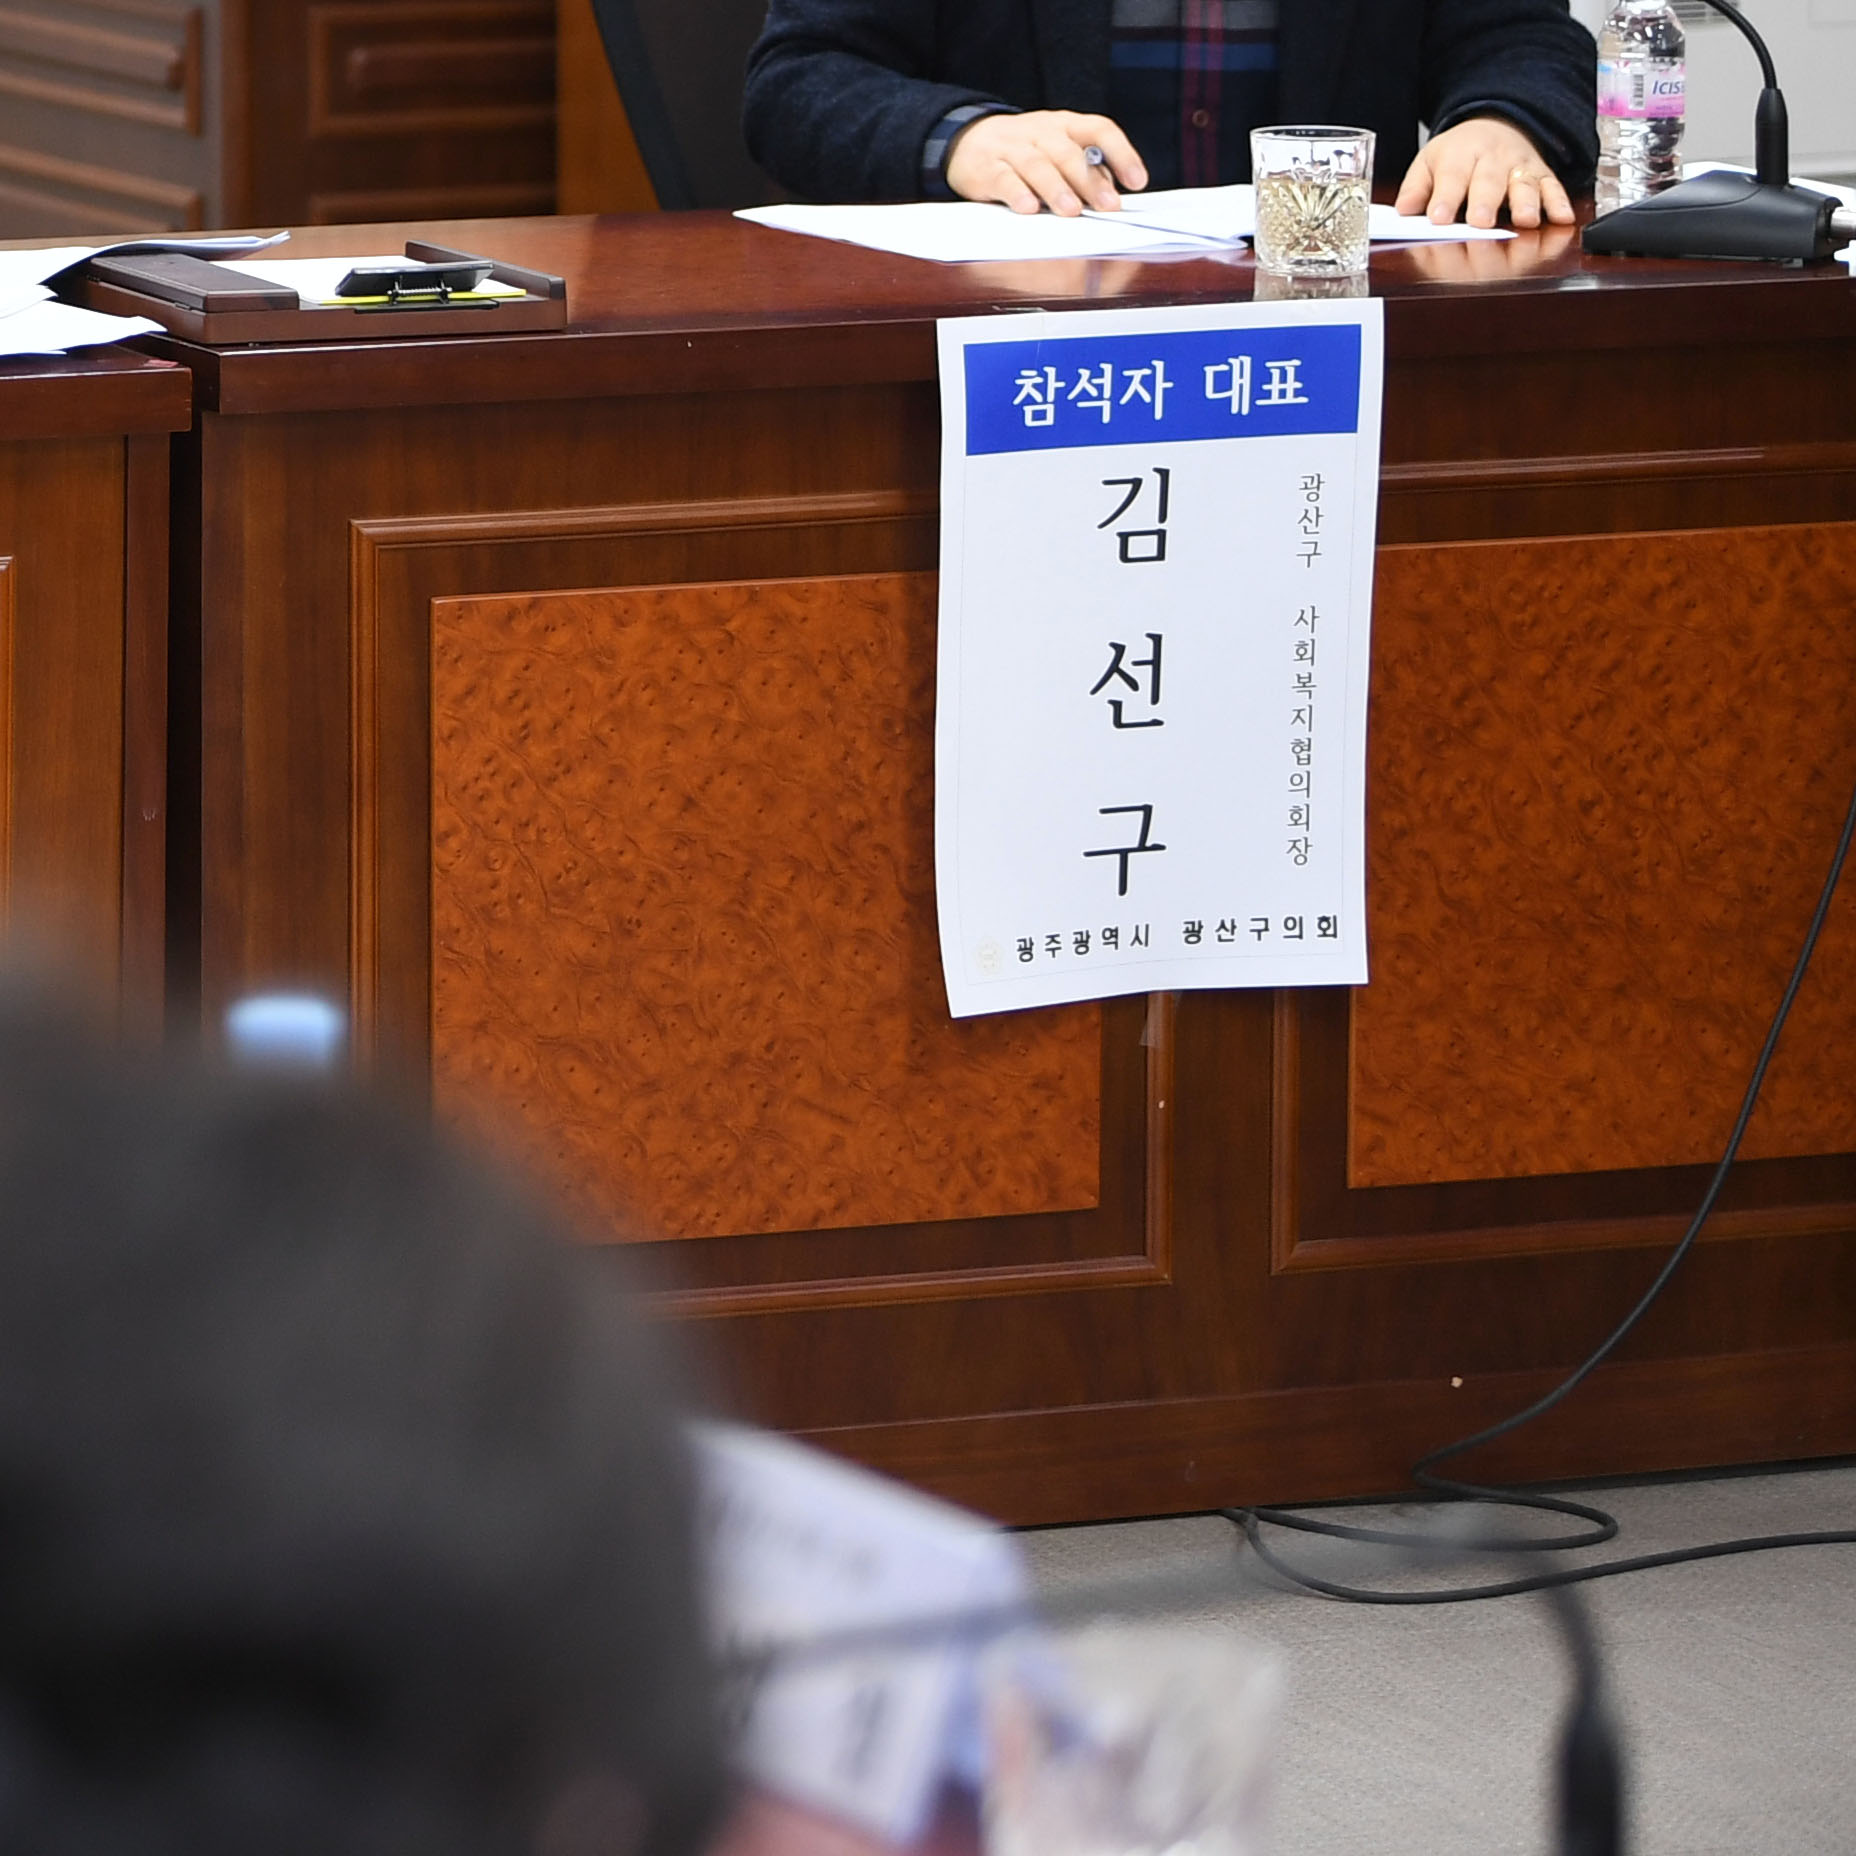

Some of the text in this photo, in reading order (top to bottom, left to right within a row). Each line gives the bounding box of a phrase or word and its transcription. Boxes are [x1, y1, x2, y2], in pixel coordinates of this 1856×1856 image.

[1012, 354, 1311, 427] 참석자 대표
[1285, 472, 1326, 868] 광산구 사회복지협의회장
[1015, 914, 1341, 964] 광주광역시 광산구의회
